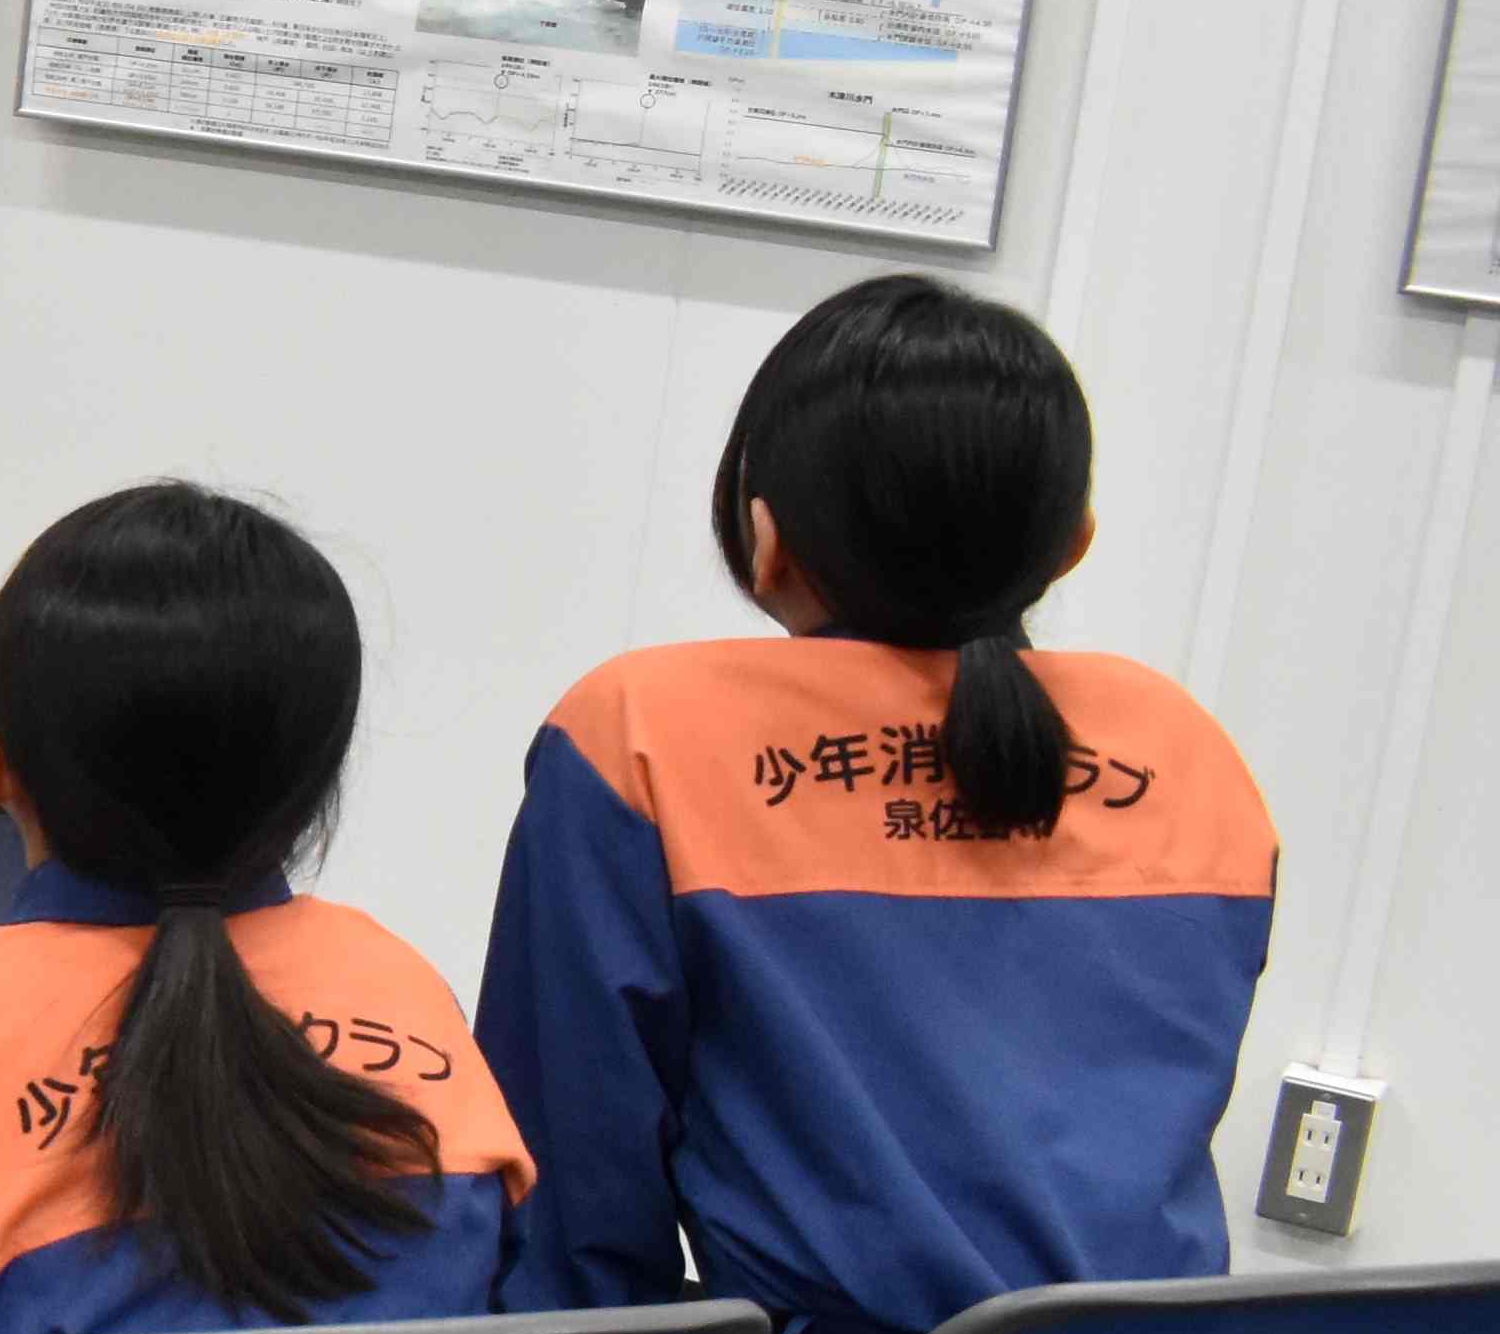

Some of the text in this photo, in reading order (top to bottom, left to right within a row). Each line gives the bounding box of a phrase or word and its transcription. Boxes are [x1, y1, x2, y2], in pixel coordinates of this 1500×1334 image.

[754, 721, 1156, 808] 少年消ラブ
